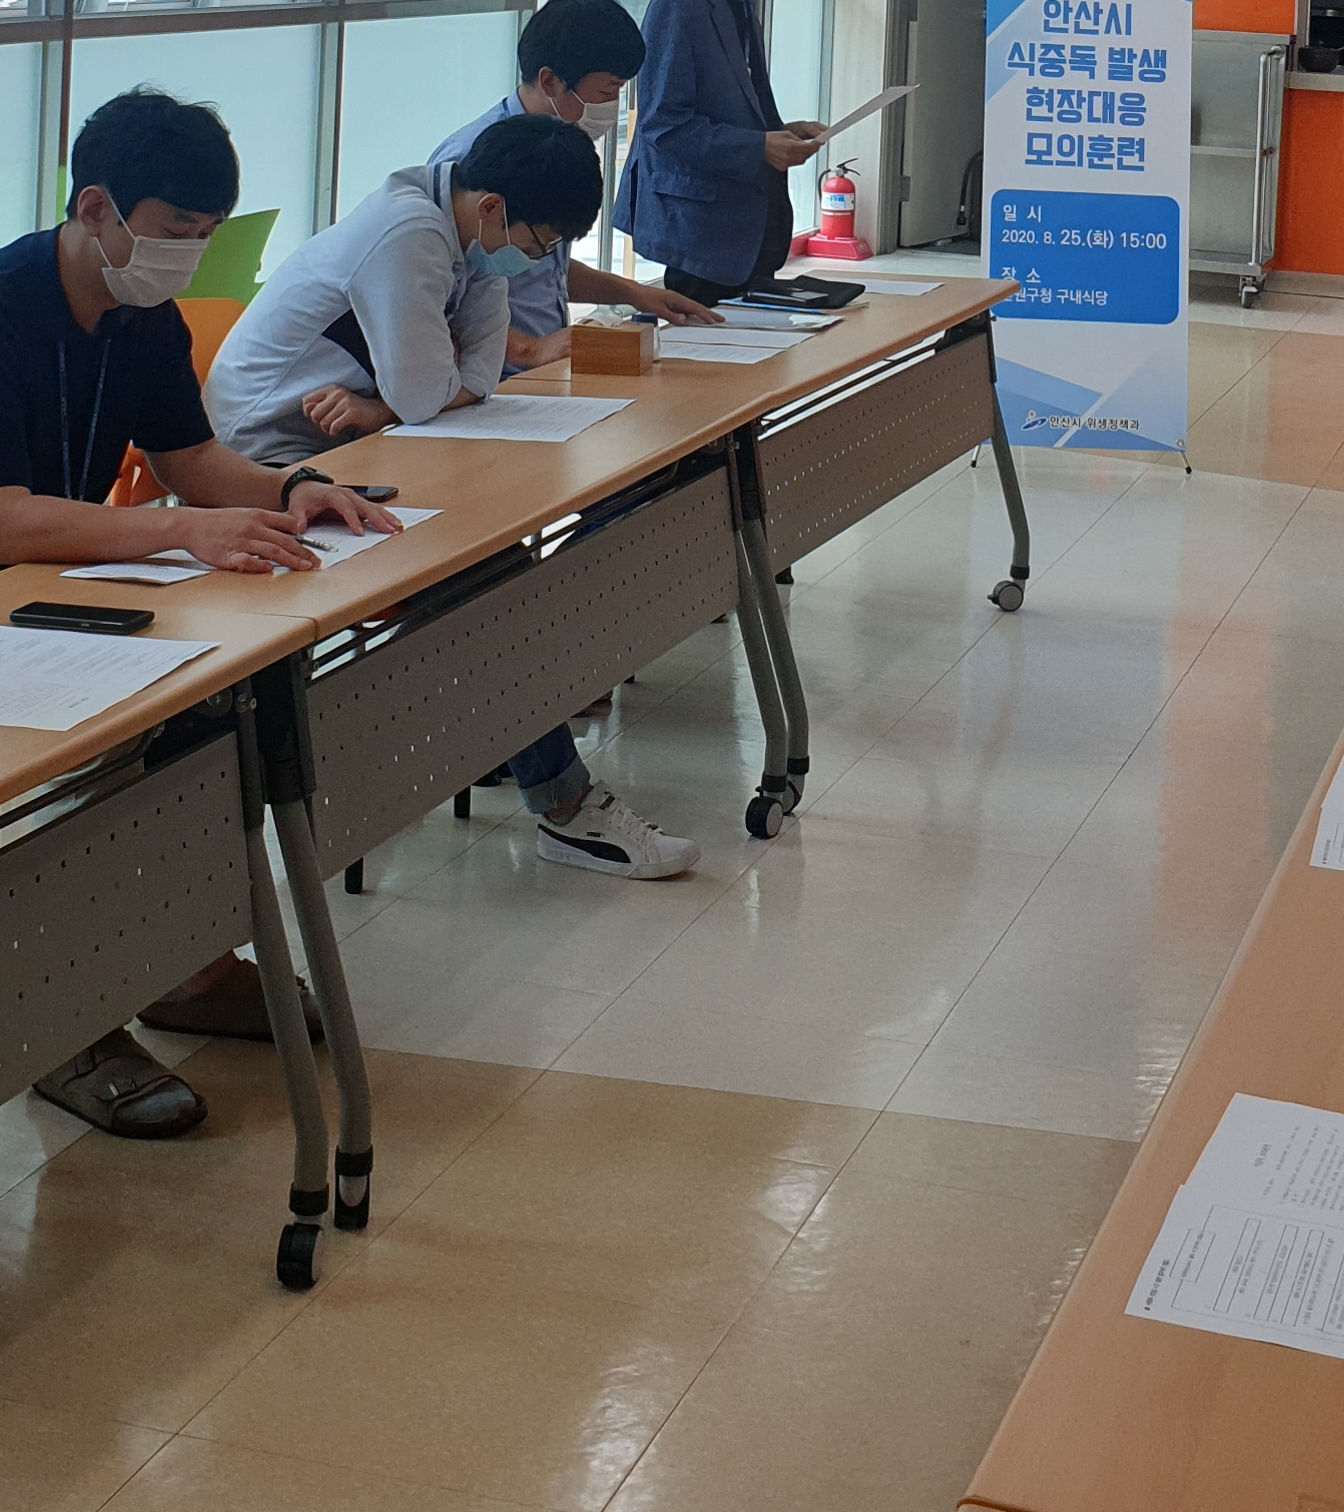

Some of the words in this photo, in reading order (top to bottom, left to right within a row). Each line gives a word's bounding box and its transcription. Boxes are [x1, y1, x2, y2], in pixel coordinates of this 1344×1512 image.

[1043, 0, 1132, 36] 안산시
[1007, 41, 1097, 80] 식중독
[1107, 47, 1167, 83] 발생
[1025, 86, 1147, 127] 현장대응
[1025, 132, 1145, 172] 모의훈련
[1003, 204, 1017, 222] 일
[1026, 205, 1042, 223] 시
[1001, 229, 1039, 244] 2020.
[1043, 232, 1056, 245] 8.
[1060, 229, 1114, 249] 25.(화)
[1120, 232, 1167, 250] 15:00
[1025, 268, 1041, 284] 소
[1056, 289, 1109, 306] 구내식당
[1050, 416, 1082, 429] 안산시
[1087, 417, 1140, 431] 위생정책과
